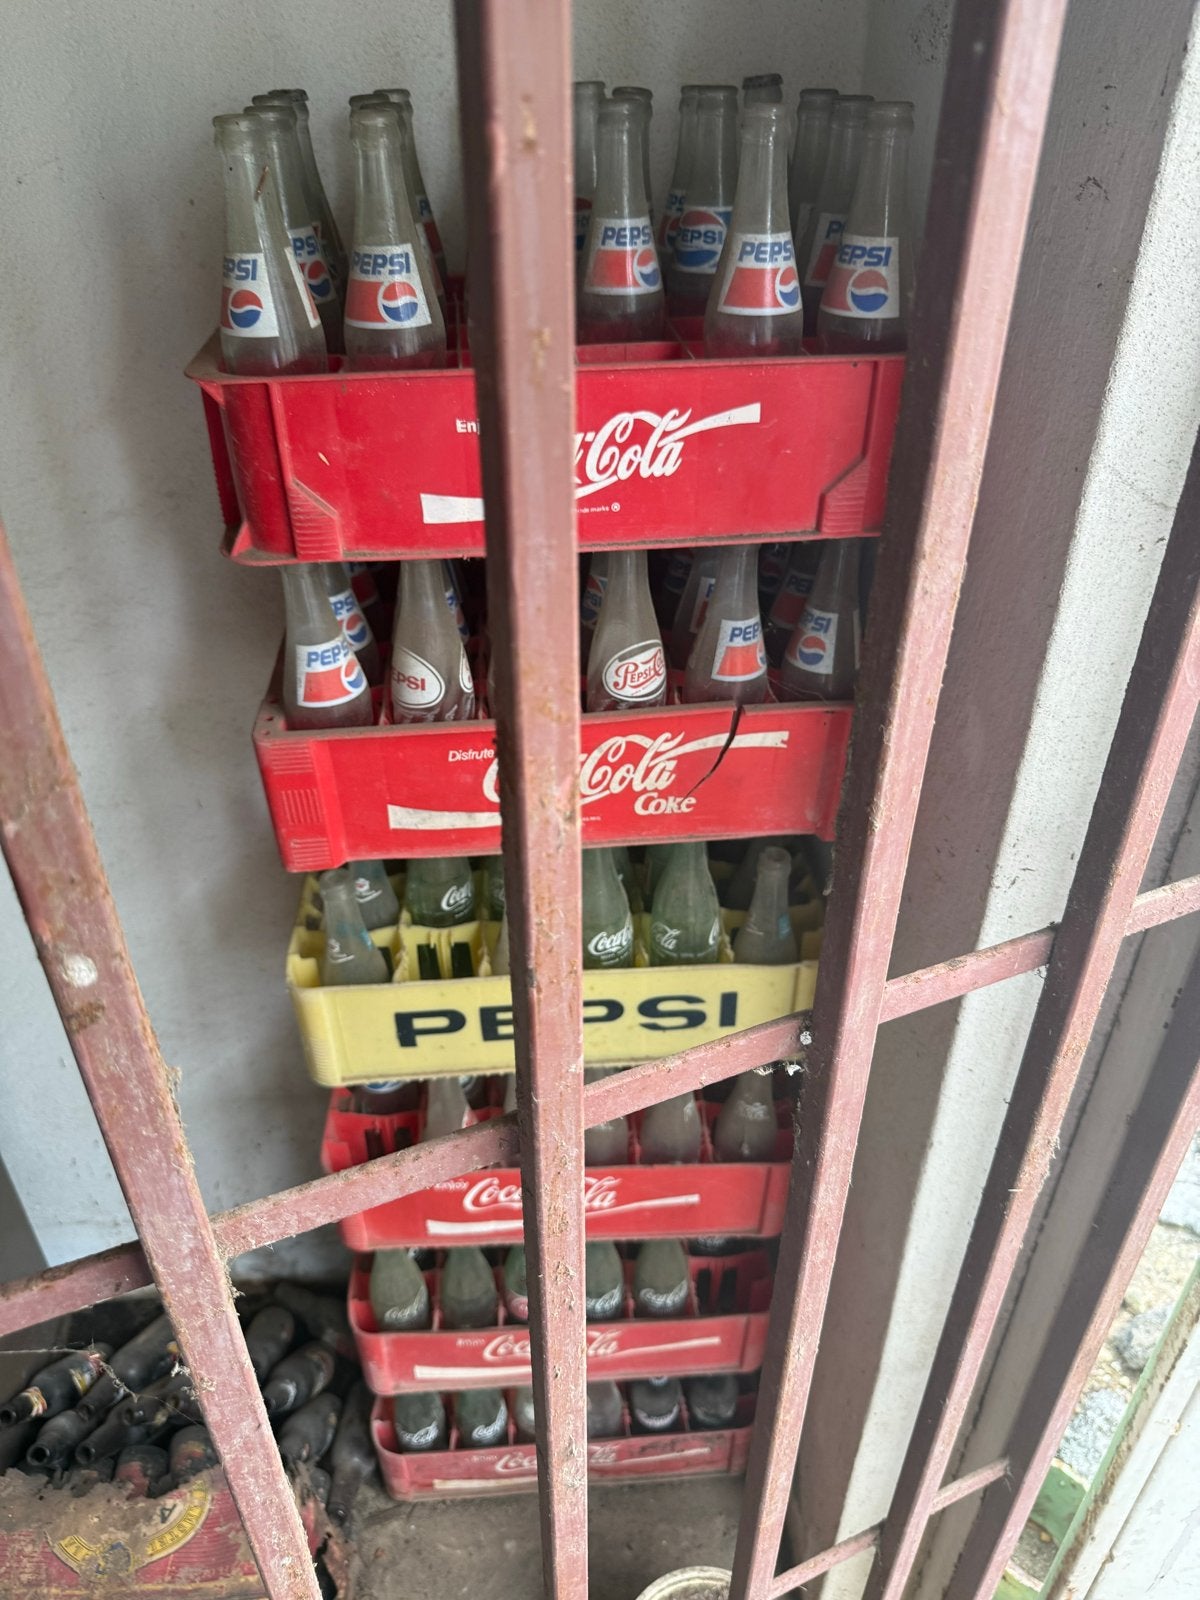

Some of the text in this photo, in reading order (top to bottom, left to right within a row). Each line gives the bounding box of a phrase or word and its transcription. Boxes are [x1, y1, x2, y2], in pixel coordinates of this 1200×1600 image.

[601, 226, 651, 247] PEPS
[738, 239, 793, 263] PEPS
[838, 244, 892, 269] EPSI
[455, 418, 481, 436] Enj
[306, 641, 350, 668] PEPS
[448, 749, 495, 763] Disfrute
[634, 792, 697, 816] Coke
[395, 990, 738, 1049] PEPSI
